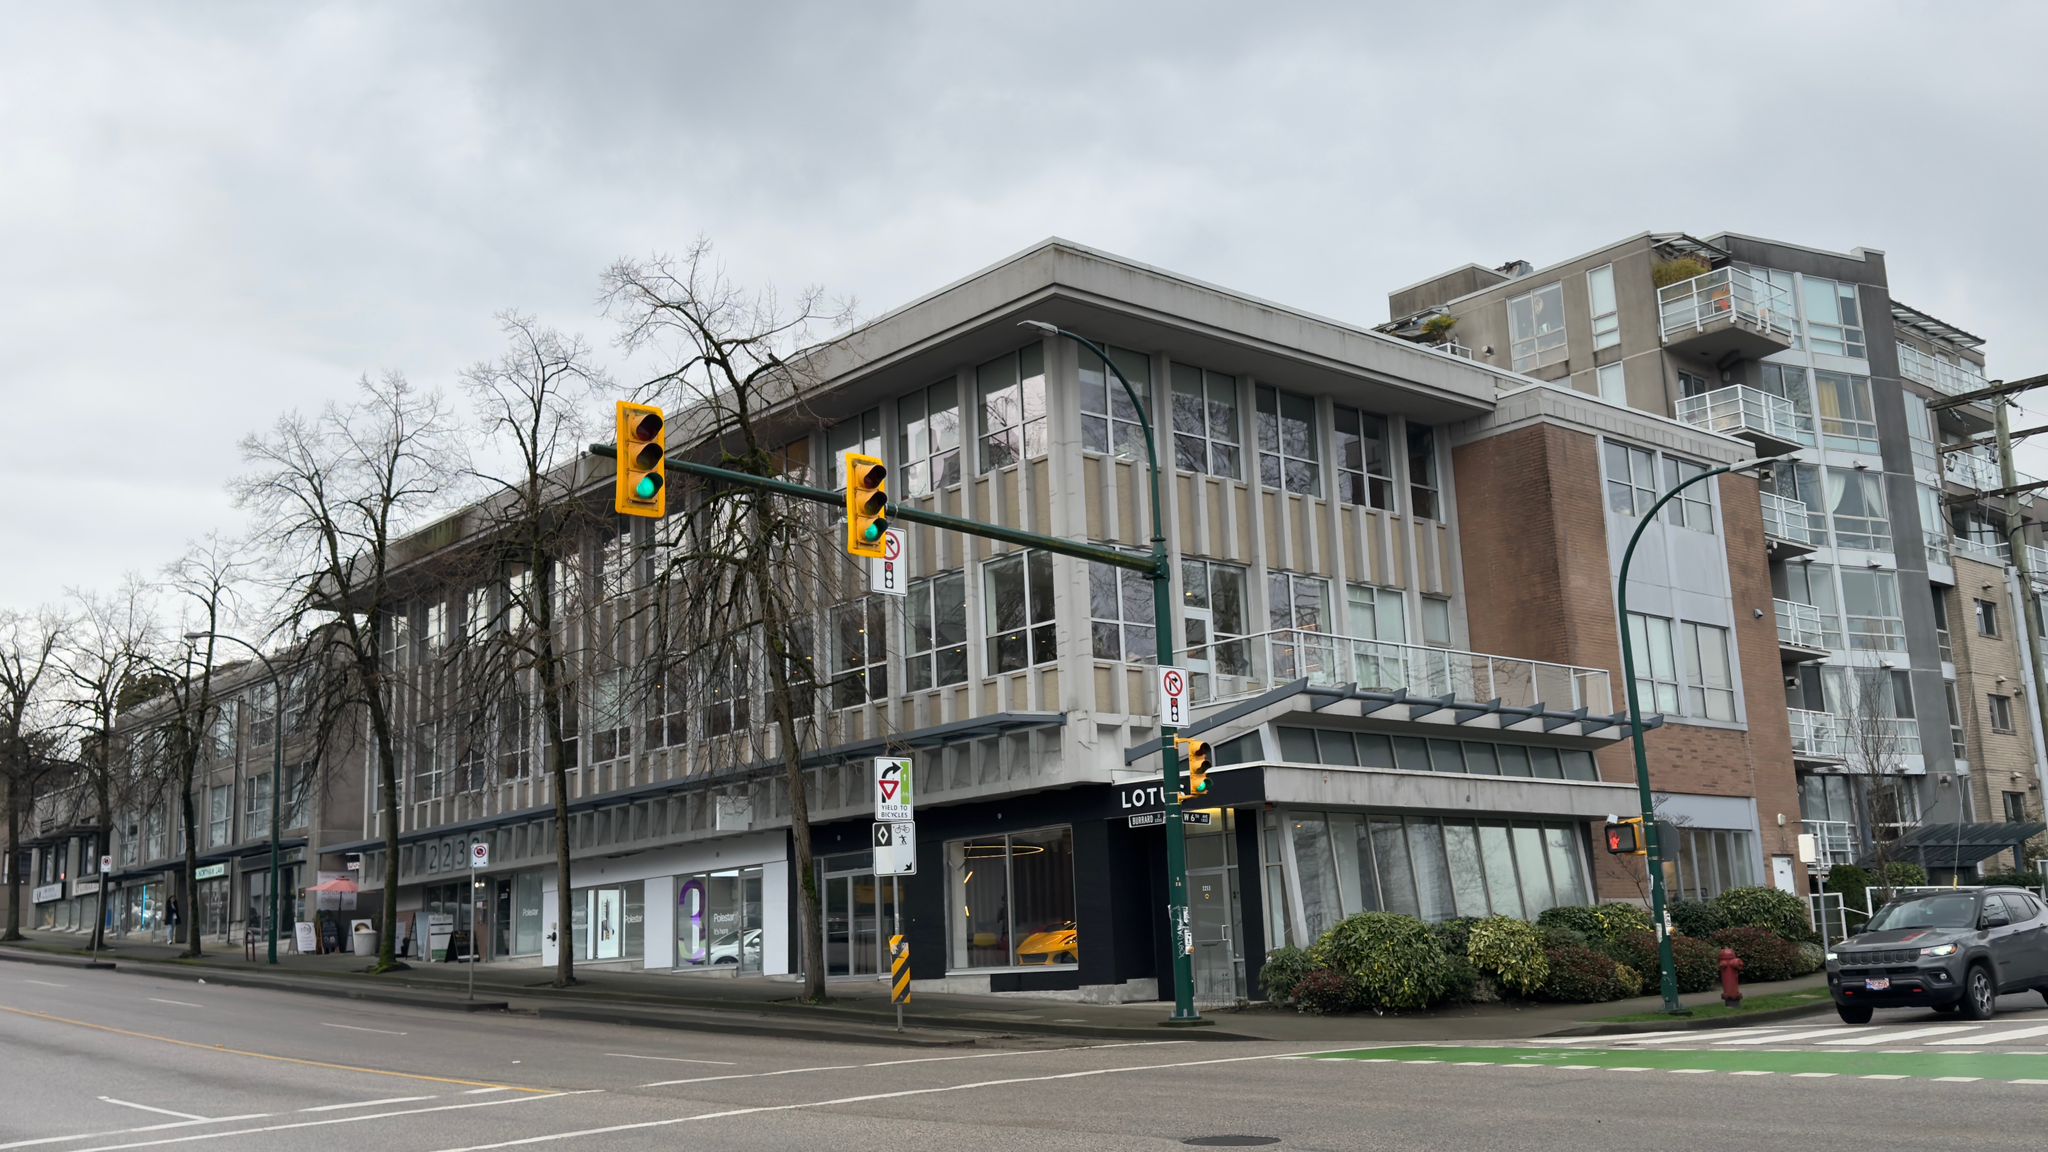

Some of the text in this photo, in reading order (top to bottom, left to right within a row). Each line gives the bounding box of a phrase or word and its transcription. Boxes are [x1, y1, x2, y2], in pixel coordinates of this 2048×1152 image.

[1121, 784, 1186, 808] LOT
[1132, 815, 1153, 825] BURRARD
[1184, 813, 1190, 821] W
[713, 913, 735, 923] Polestar
